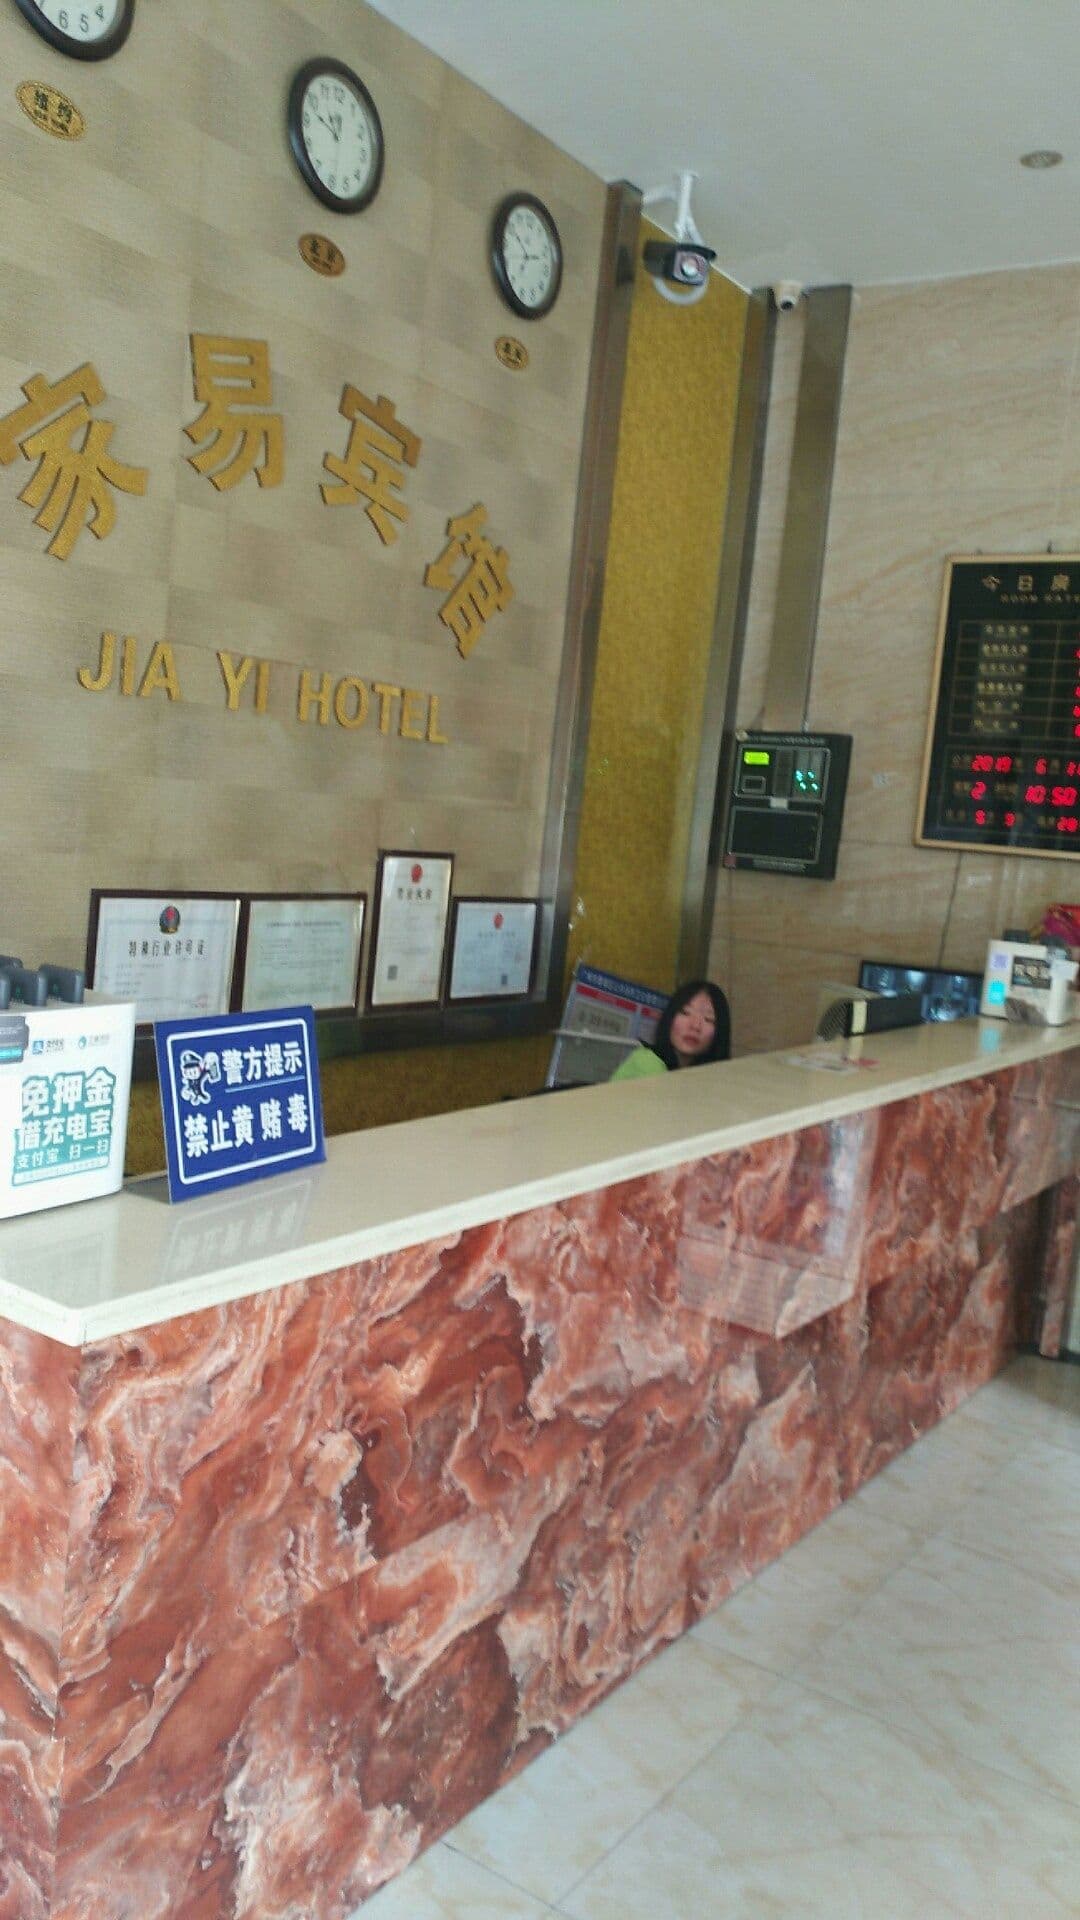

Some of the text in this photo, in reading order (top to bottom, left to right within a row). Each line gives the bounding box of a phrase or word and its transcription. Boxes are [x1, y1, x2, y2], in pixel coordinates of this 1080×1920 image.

[59, 9, 69, 29] 6
[79, 13, 89, 33] 5
[0, 333, 515, 660] 家易宾馆
[78, 632, 449, 744] JIA YI HOTEL
[222, 1041, 303, 1085] 警方提示
[22, 1069, 114, 1117] 免押金
[18, 1110, 111, 1151] 借充电宝
[184, 1093, 308, 1158] 禁止黄赌毒
[17, 1148, 59, 1169] 支付宝
